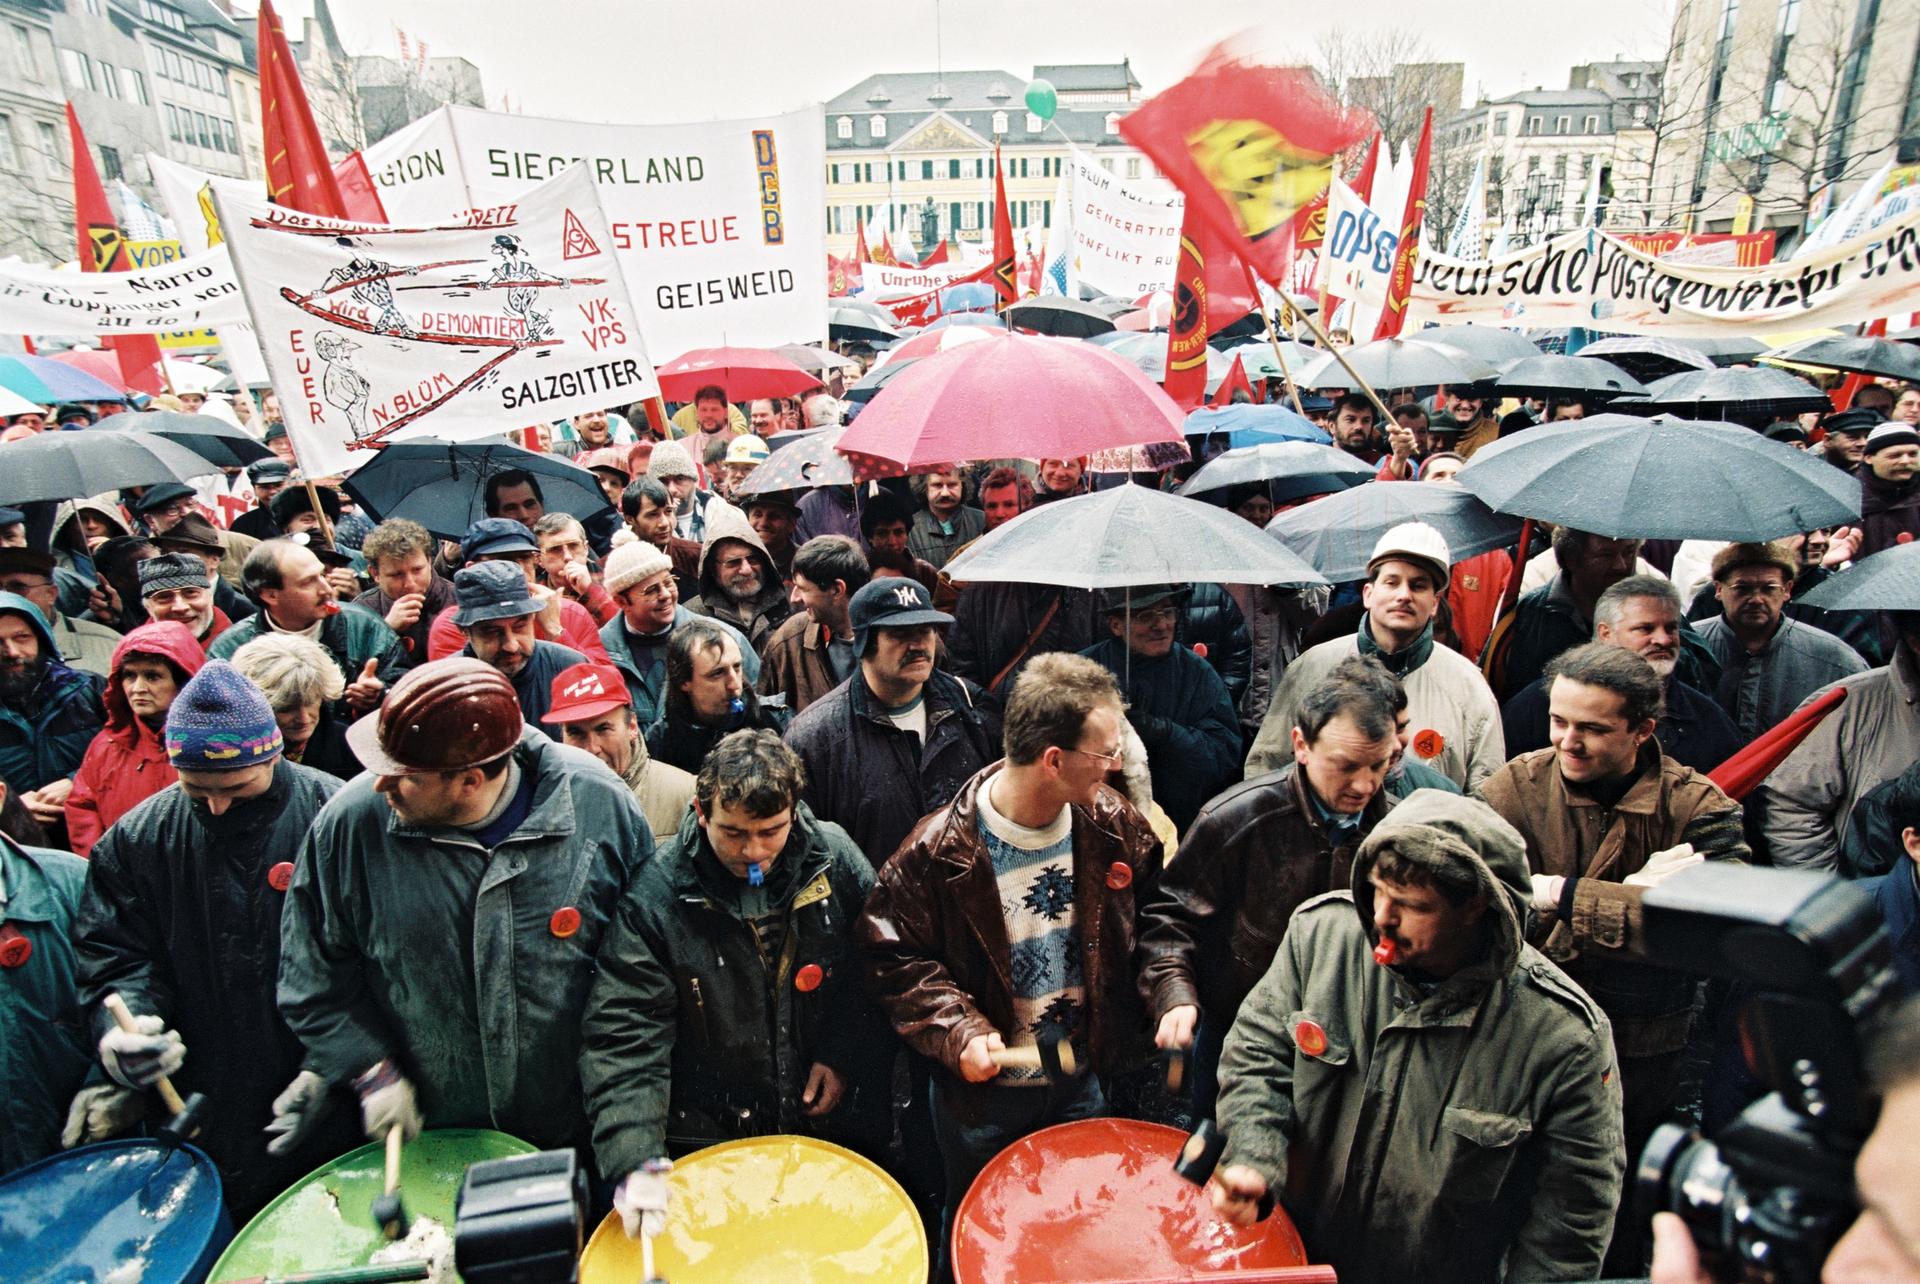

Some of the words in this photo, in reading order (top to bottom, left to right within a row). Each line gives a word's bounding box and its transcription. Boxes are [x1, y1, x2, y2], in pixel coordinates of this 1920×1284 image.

[370, 149, 445, 187] GION
[488, 148, 705, 185] SIEGRLAND
[755, 132, 782, 243] DGB
[265, 208, 311, 226] Das
[1085, 203, 1181, 238] GENERATIO
[1074, 230, 1143, 265] ONFLIKT
[1330, 207, 1399, 275] DPG
[4, 282, 30, 297] ir
[127, 266, 213, 294] Narro
[657, 268, 795, 310] GEISWEID
[881, 272, 942, 288] Unruhe
[421, 311, 526, 338] DEMONTIERT
[580, 322, 628, 352] VPS
[290, 329, 326, 425] EUER
[501, 358, 643, 410] SALZGITTER
